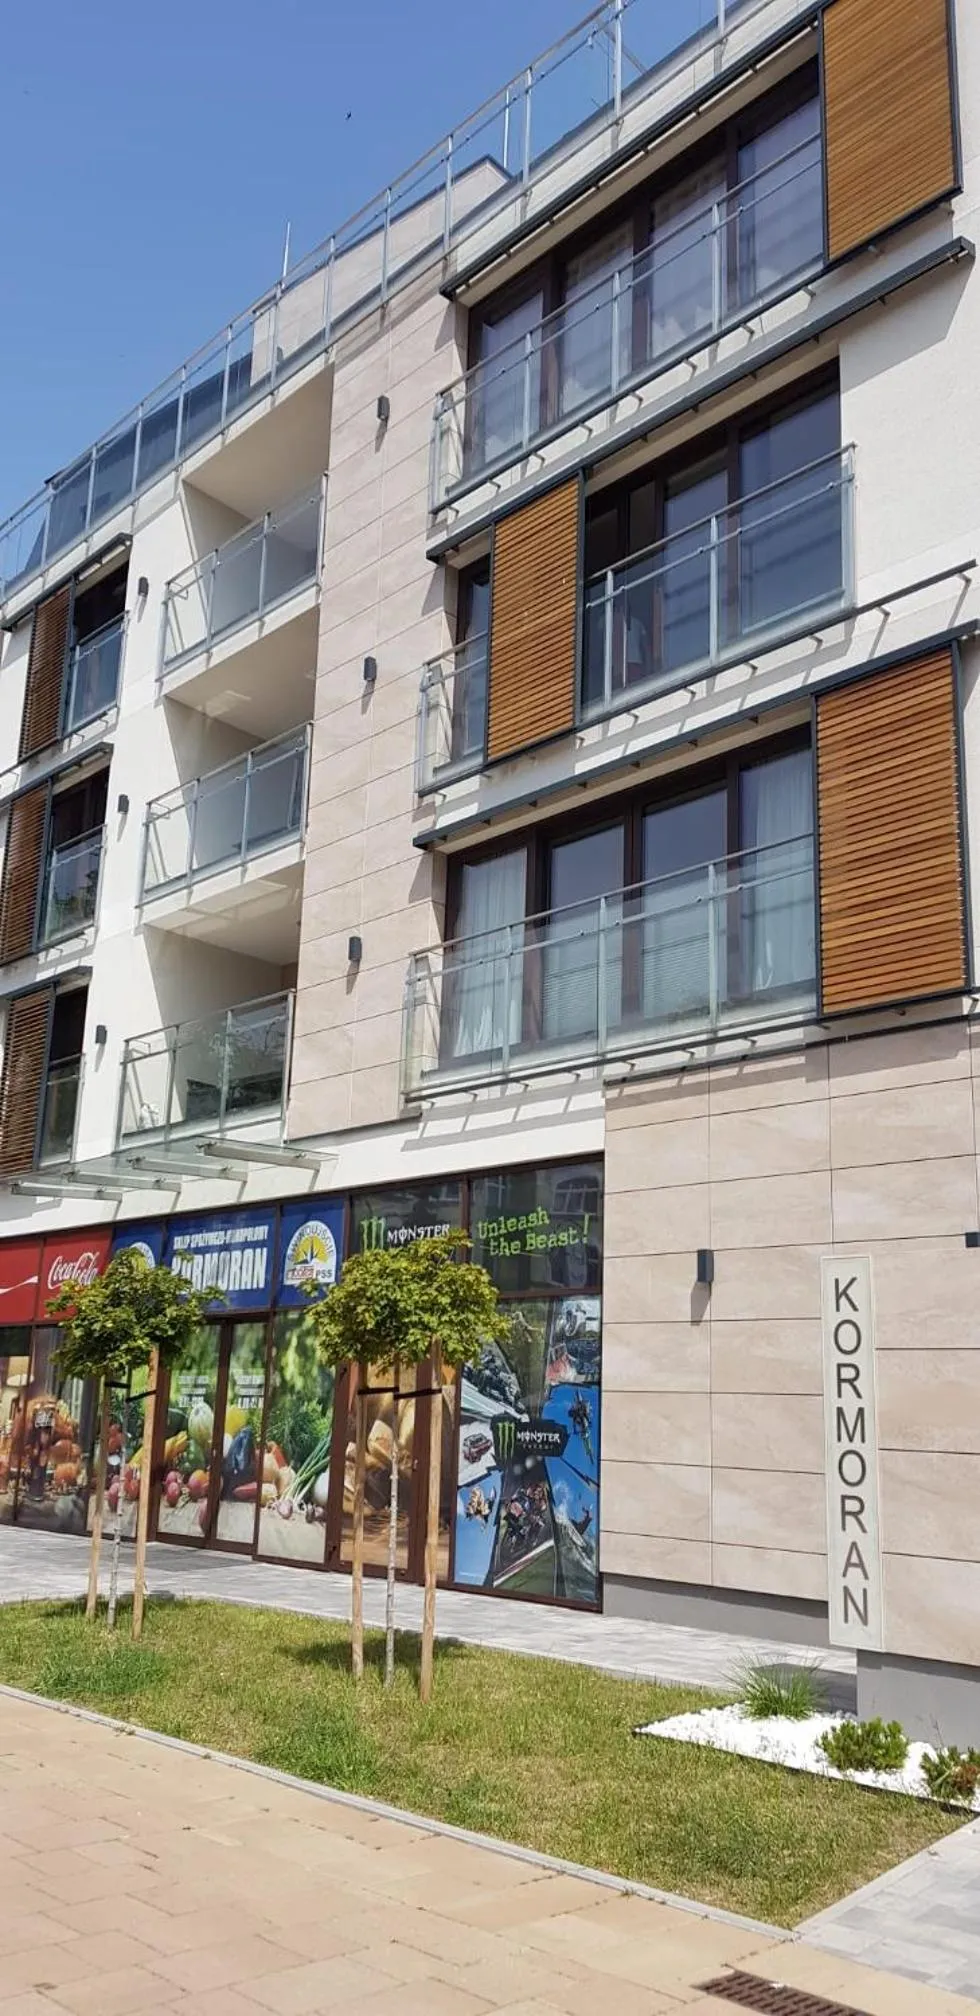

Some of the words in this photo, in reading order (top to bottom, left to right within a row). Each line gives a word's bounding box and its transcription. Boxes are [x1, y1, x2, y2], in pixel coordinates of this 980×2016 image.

[478, 1206, 549, 1239] Unleash
[489, 1238, 521, 1256] the
[833, 1276, 870, 1627] KORMORAN
